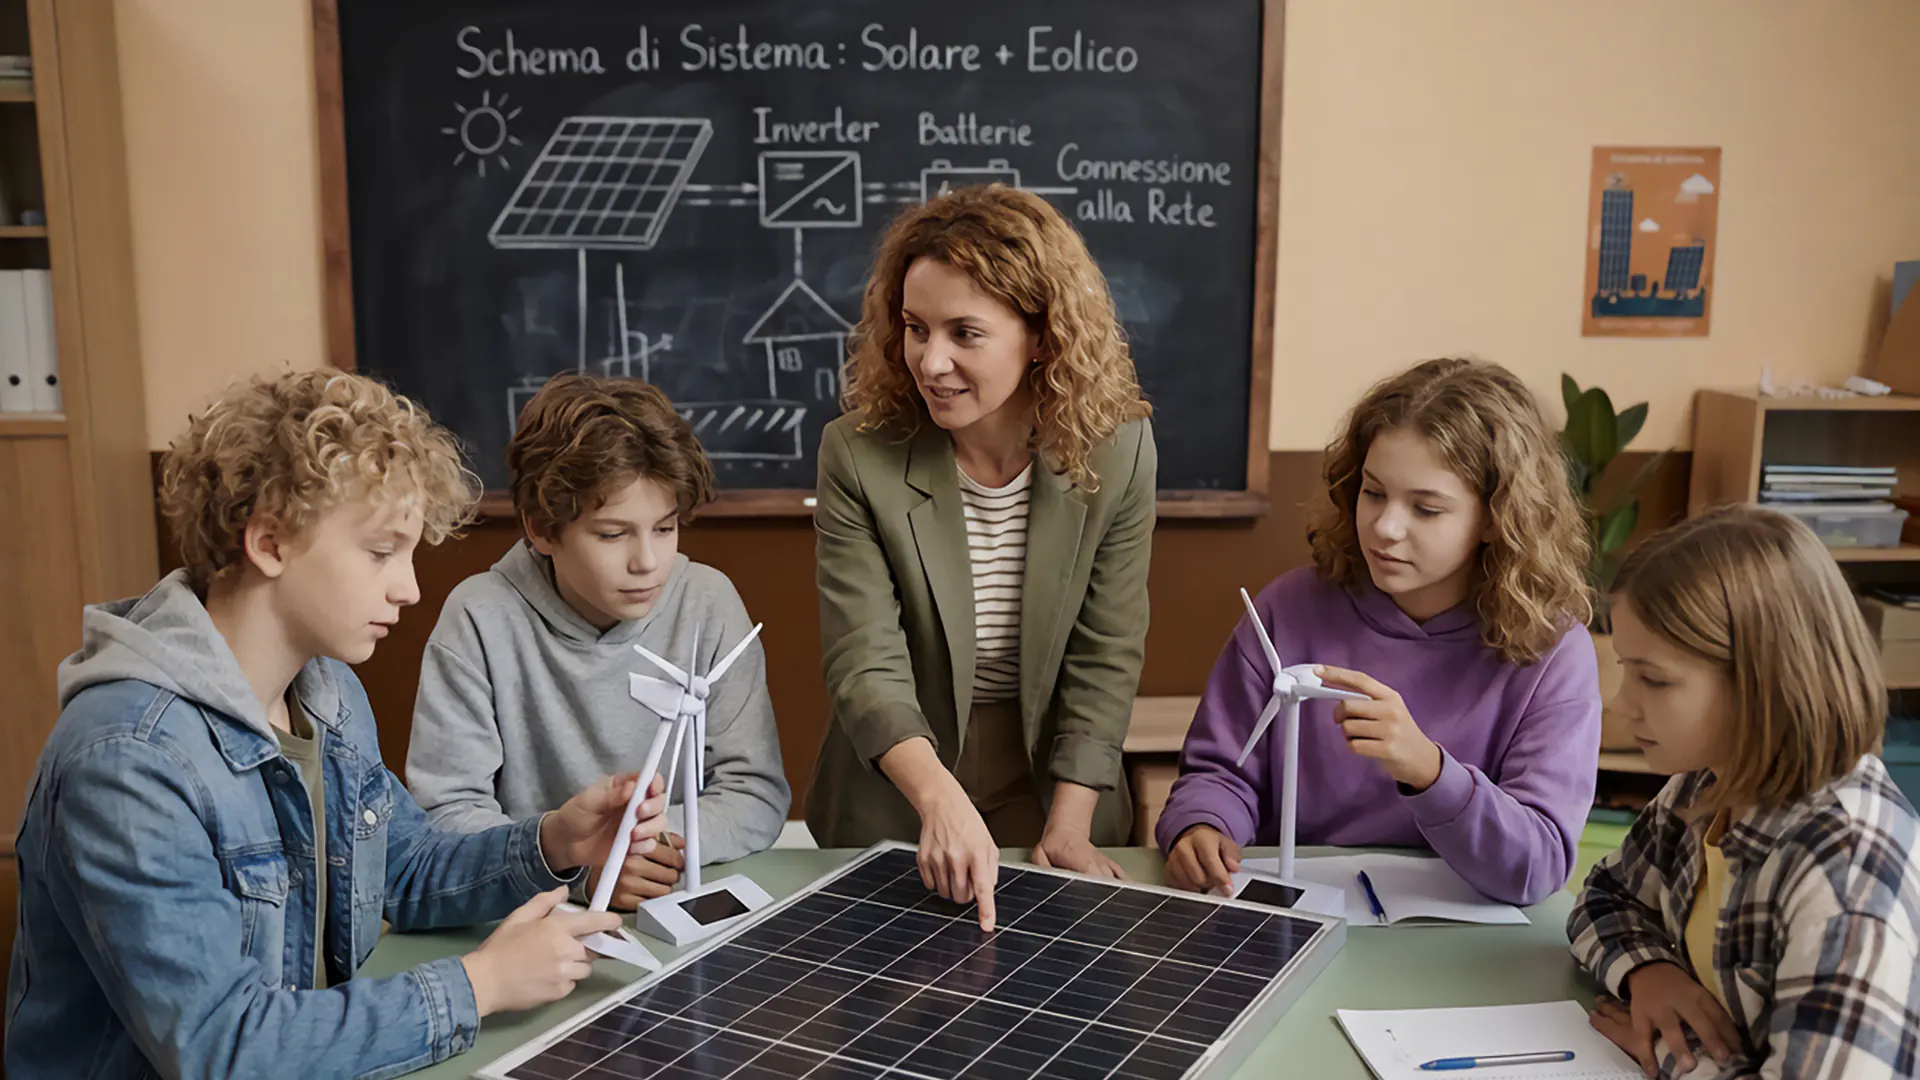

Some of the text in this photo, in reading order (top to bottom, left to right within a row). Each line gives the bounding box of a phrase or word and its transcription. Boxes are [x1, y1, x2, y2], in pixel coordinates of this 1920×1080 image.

[456, 25, 606, 78] Schema
[626, 25, 661, 72] di
[861, 23, 982, 72] Solare
[995, 44, 1015, 67] +
[1027, 25, 1140, 73] Eolico
[753, 106, 880, 145] Inverter
[918, 111, 1034, 147] Batterie
[1056, 142, 1232, 186] Connessione
[1076, 187, 1217, 228] alla Rete
